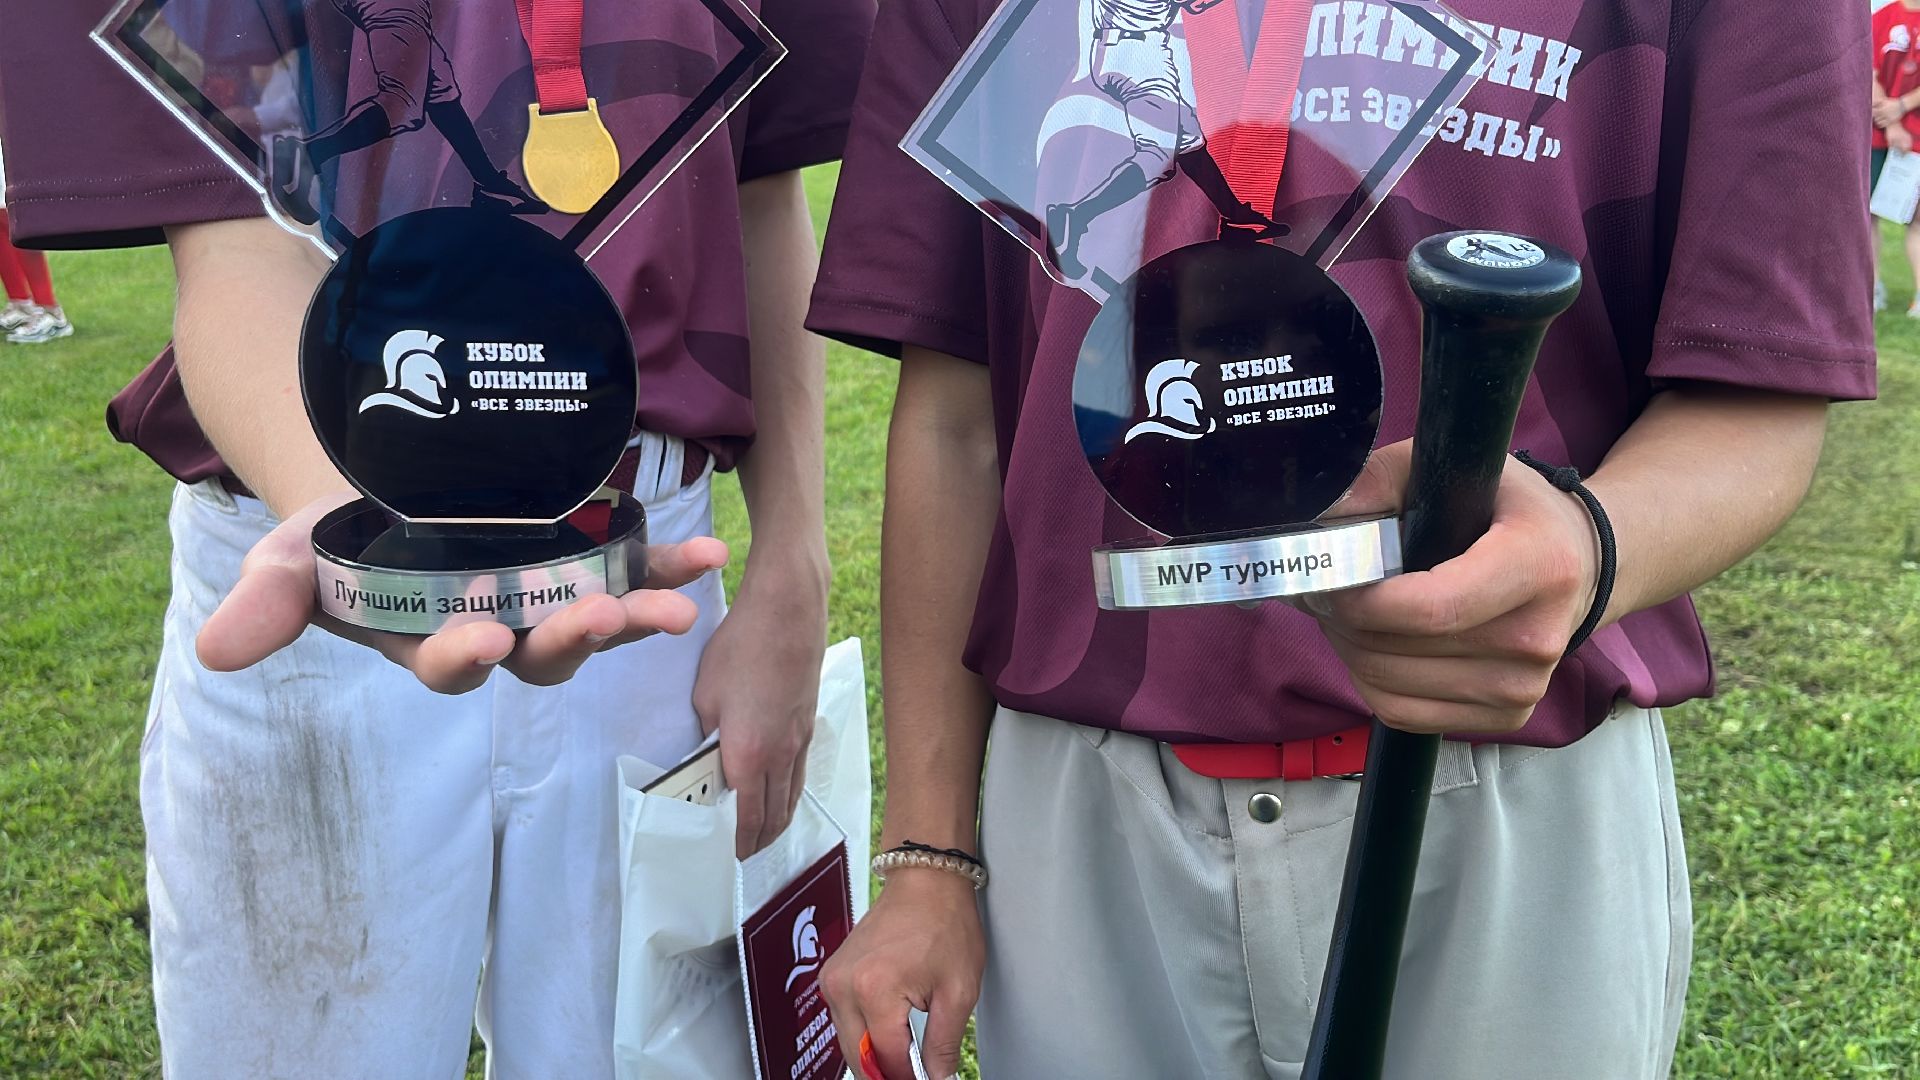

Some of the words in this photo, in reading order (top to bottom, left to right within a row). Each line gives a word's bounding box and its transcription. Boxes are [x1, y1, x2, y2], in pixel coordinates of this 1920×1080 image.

[1303, 0, 1583, 102] ЛИМПИИ
[466, 343, 546, 362] КУБОК
[469, 370, 588, 390] ОЛИМПИИ
[1220, 355, 1293, 382] КУБОК
[471, 398, 509, 411] «ВСЕ
[514, 398, 589, 413] ЗВЕЗДЫ»
[1223, 375, 1335, 407] ОЛИМПИИ
[1226, 411, 1262, 427] «ВСЕ
[1266, 402, 1336, 422] ЗВЕЗДЫ»
[1157, 561, 1212, 586] MVP
[1219, 552, 1333, 585] турнира
[335, 578, 427, 614] Лучший
[436, 581, 577, 615] защитник
[796, 1007, 829, 1052] КУБОК
